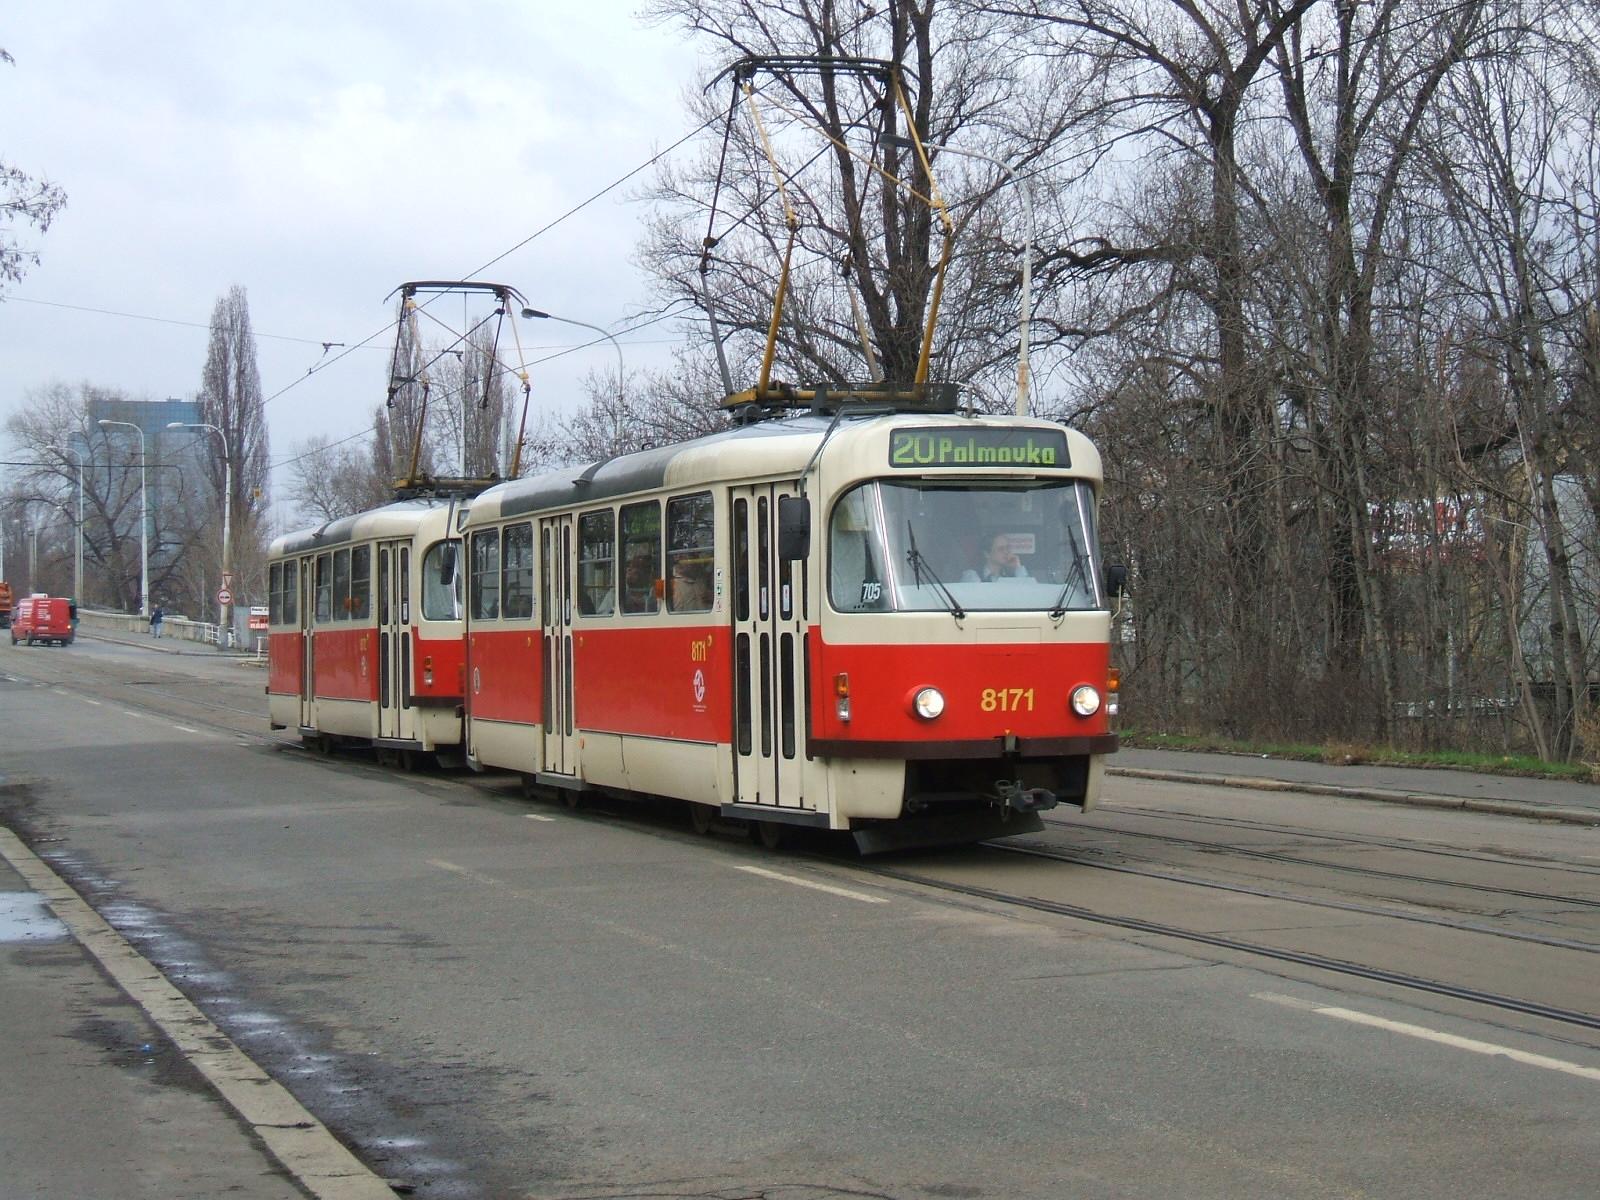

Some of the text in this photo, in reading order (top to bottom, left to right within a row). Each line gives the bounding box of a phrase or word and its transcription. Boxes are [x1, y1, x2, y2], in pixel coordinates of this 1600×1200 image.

[893, 434, 1056, 464] 20 Palmovka
[862, 583, 881, 600] 705
[691, 640, 706, 661] 8171
[980, 688, 1034, 711] 8171
